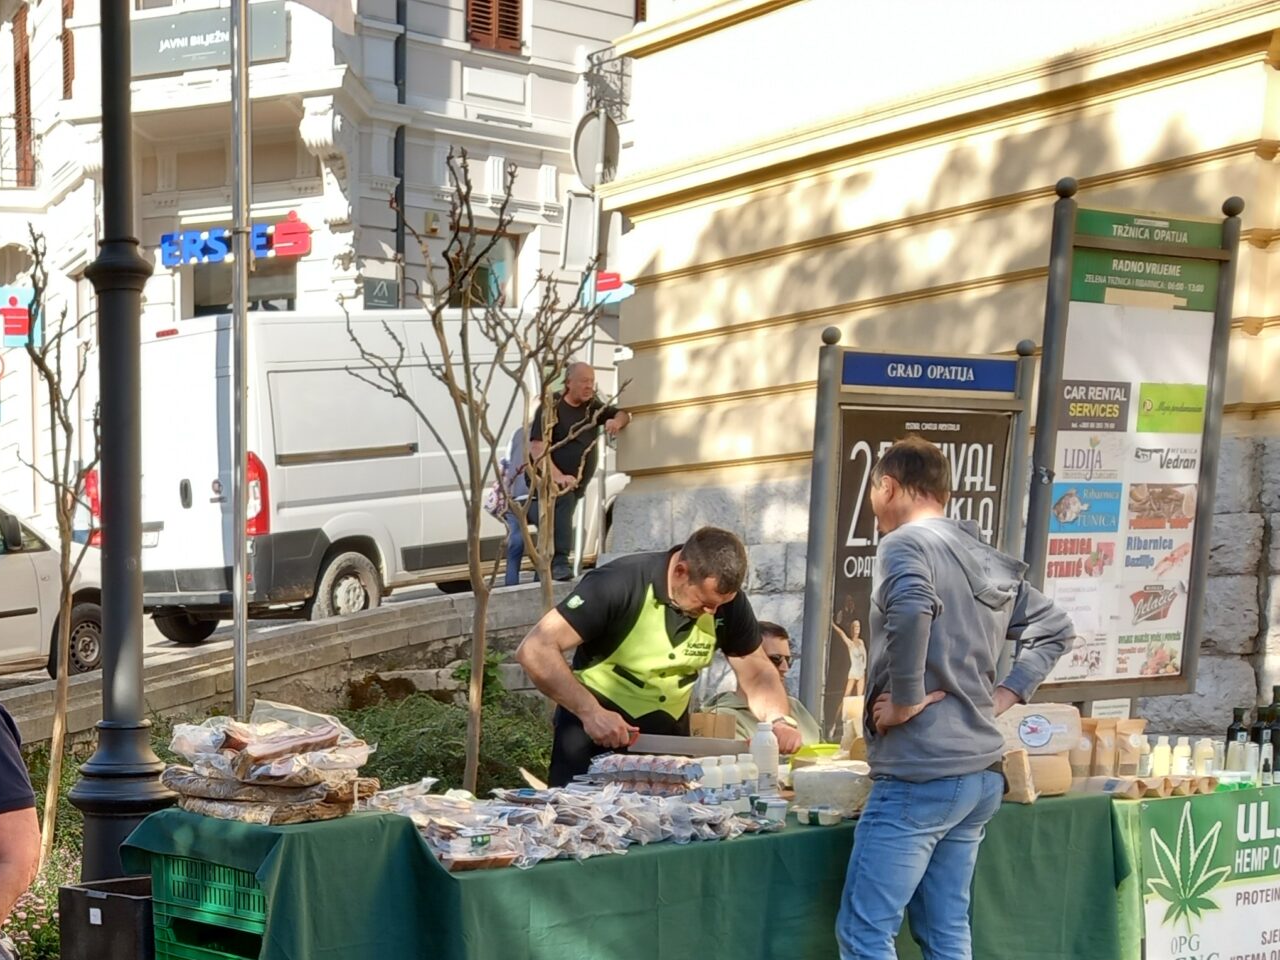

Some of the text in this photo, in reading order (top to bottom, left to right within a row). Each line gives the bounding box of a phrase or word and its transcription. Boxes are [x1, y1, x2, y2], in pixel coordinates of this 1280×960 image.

[159, 30, 230, 52] JAVNI BILJEŽN
[1112, 224, 1189, 244] TRŽNICA OPATIJA
[161, 222, 270, 268] ERSE
[1112, 259, 1181, 277] RADNO VRIJEME
[887, 363, 975, 382] GRAD OPATIJA
[1063, 385, 1127, 401] CAR RENTAL
[1069, 403, 1120, 418] SERVICES
[1063, 449, 1102, 479] LIDIJA
[1160, 448, 1197, 469] Vedran
[1048, 538, 1092, 556] MESNICA
[1126, 536, 1174, 550] Ribarnica
[844, 555, 877, 578] OPAT
[1235, 846, 1270, 874] HEMP
[1171, 934, 1200, 954] OPG
